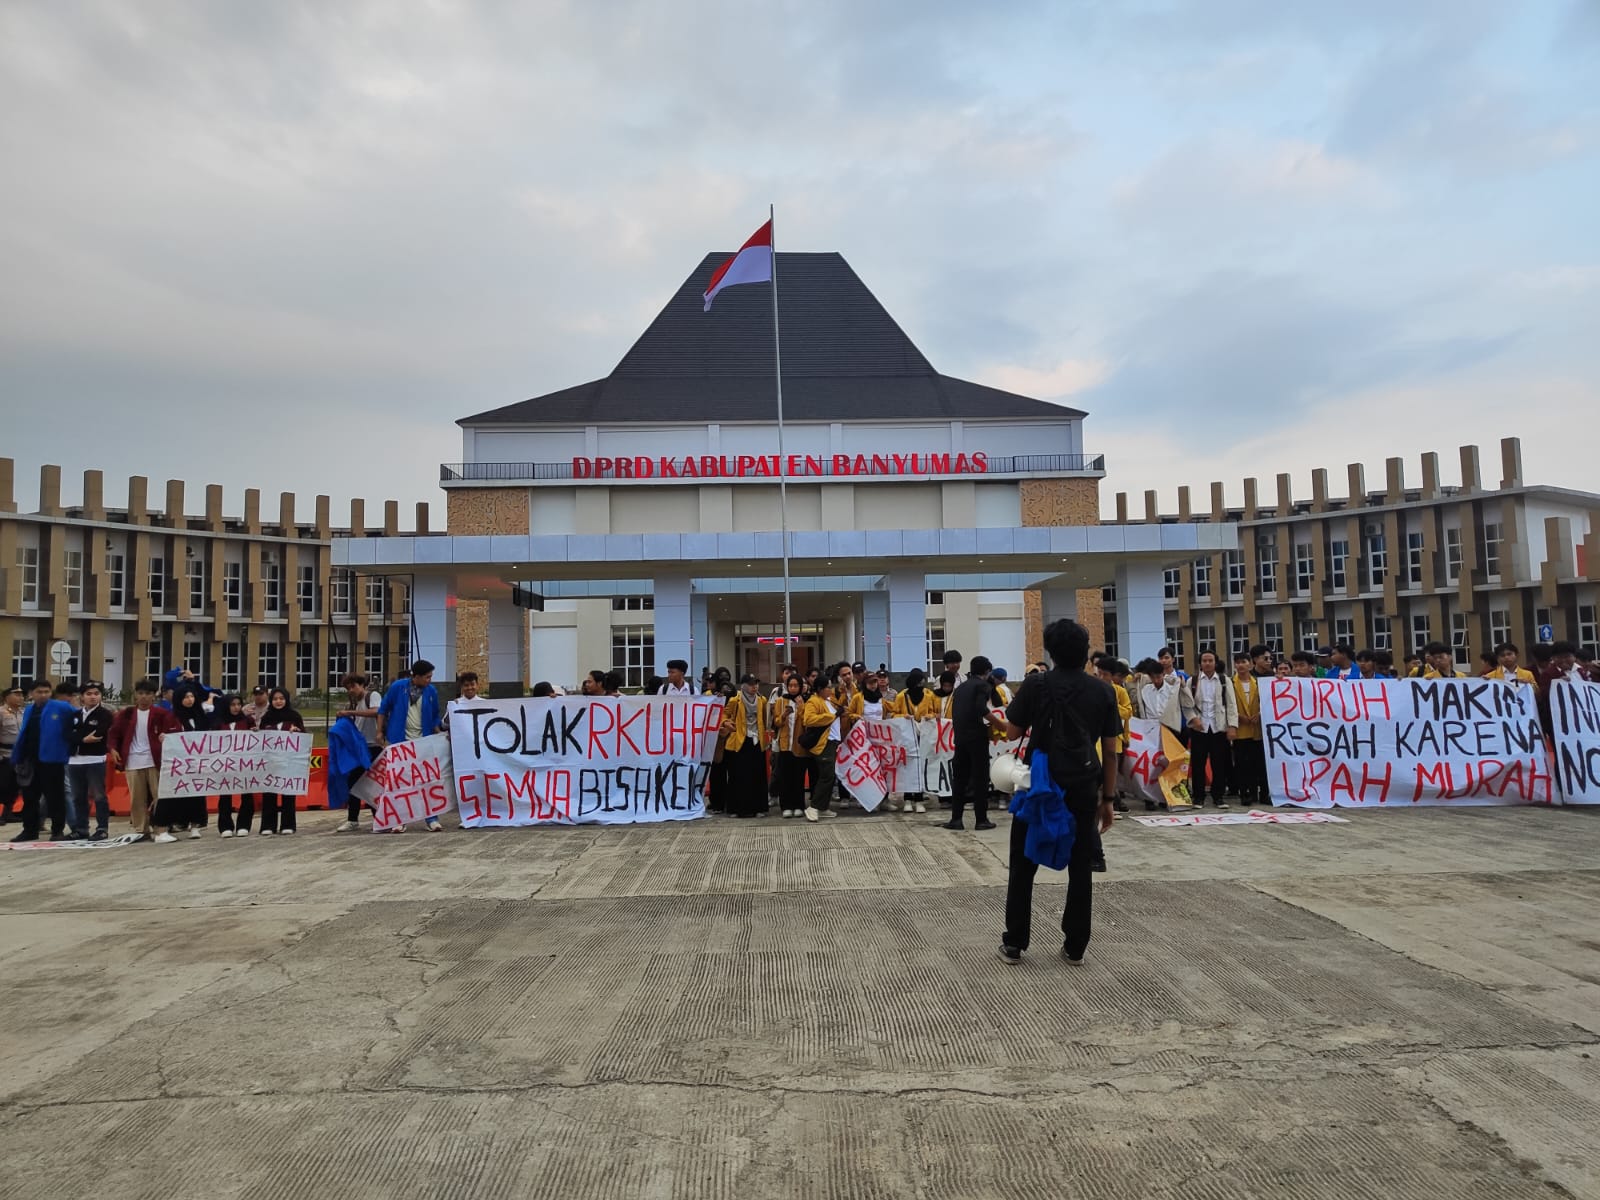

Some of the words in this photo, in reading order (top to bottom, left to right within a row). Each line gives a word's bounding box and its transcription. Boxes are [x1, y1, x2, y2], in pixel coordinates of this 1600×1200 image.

[572, 456, 655, 480] DPRD
[659, 454, 824, 479] KABUPATEN
[832, 451, 988, 476] BANYUMAS
[1271, 679, 1391, 723] BURUH
[180, 733, 300, 755] WUJUDKAN
[454, 704, 587, 760] TOLAK
[1266, 722, 1376, 760] RESAH
[1395, 720, 1547, 758] KARENA
[170, 757, 268, 777] REFORMA
[174, 776, 260, 794] AGRARIA
[263, 773, 306, 791] SEJATI
[1281, 757, 1392, 803] UPAH
[1412, 757, 1553, 805] MURAH
[459, 769, 572, 822] SEMUA
